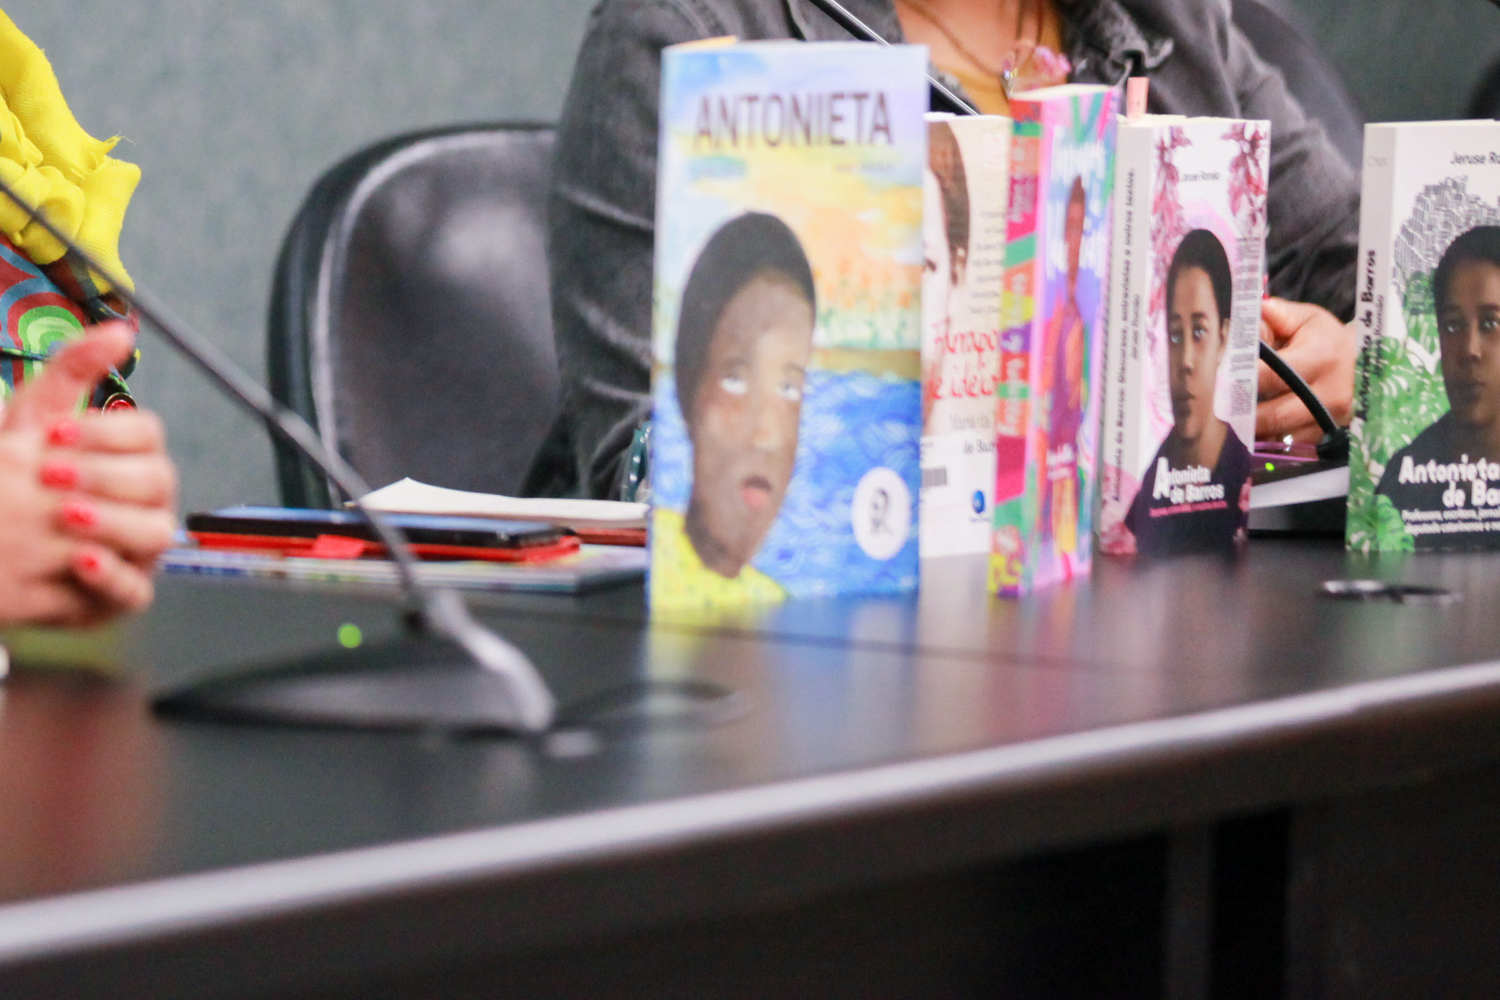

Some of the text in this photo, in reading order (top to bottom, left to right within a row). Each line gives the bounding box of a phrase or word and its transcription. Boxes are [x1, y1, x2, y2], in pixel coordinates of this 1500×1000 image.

[694, 91, 894, 149] ANTONIETA
[1450, 151, 1486, 165] Jeruse
[1355, 249, 1376, 421] Antonieta de Barros
[1152, 456, 1211, 500] Antonieta
[1398, 453, 1500, 484] Antonieta
[1170, 483, 1225, 504] de Barros
[1442, 480, 1466, 508] de
